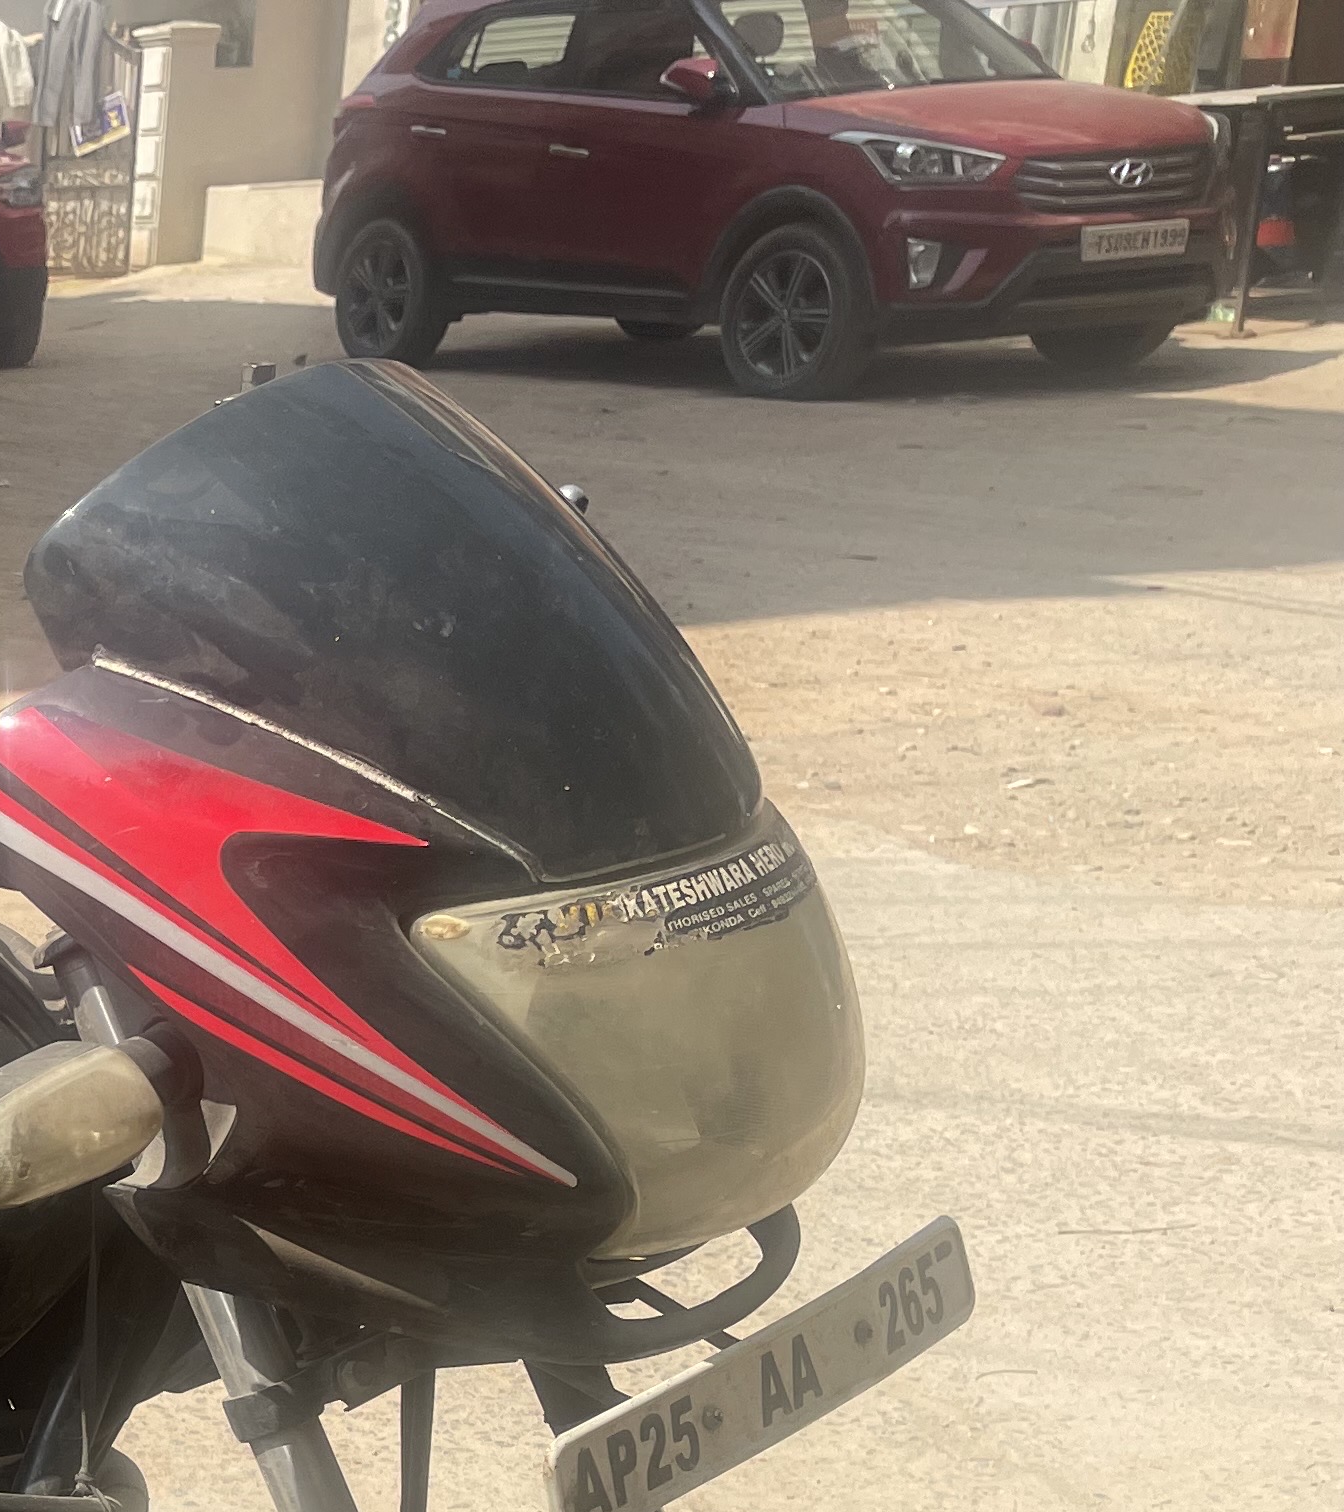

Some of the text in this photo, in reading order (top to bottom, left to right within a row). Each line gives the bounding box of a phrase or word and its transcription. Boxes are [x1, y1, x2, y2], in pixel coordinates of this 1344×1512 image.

[755, 843, 786, 878] HERO
[725, 892, 759, 917] SALES
[703, 913, 745, 936] KONDA
[760, 1332, 824, 1429] AA
